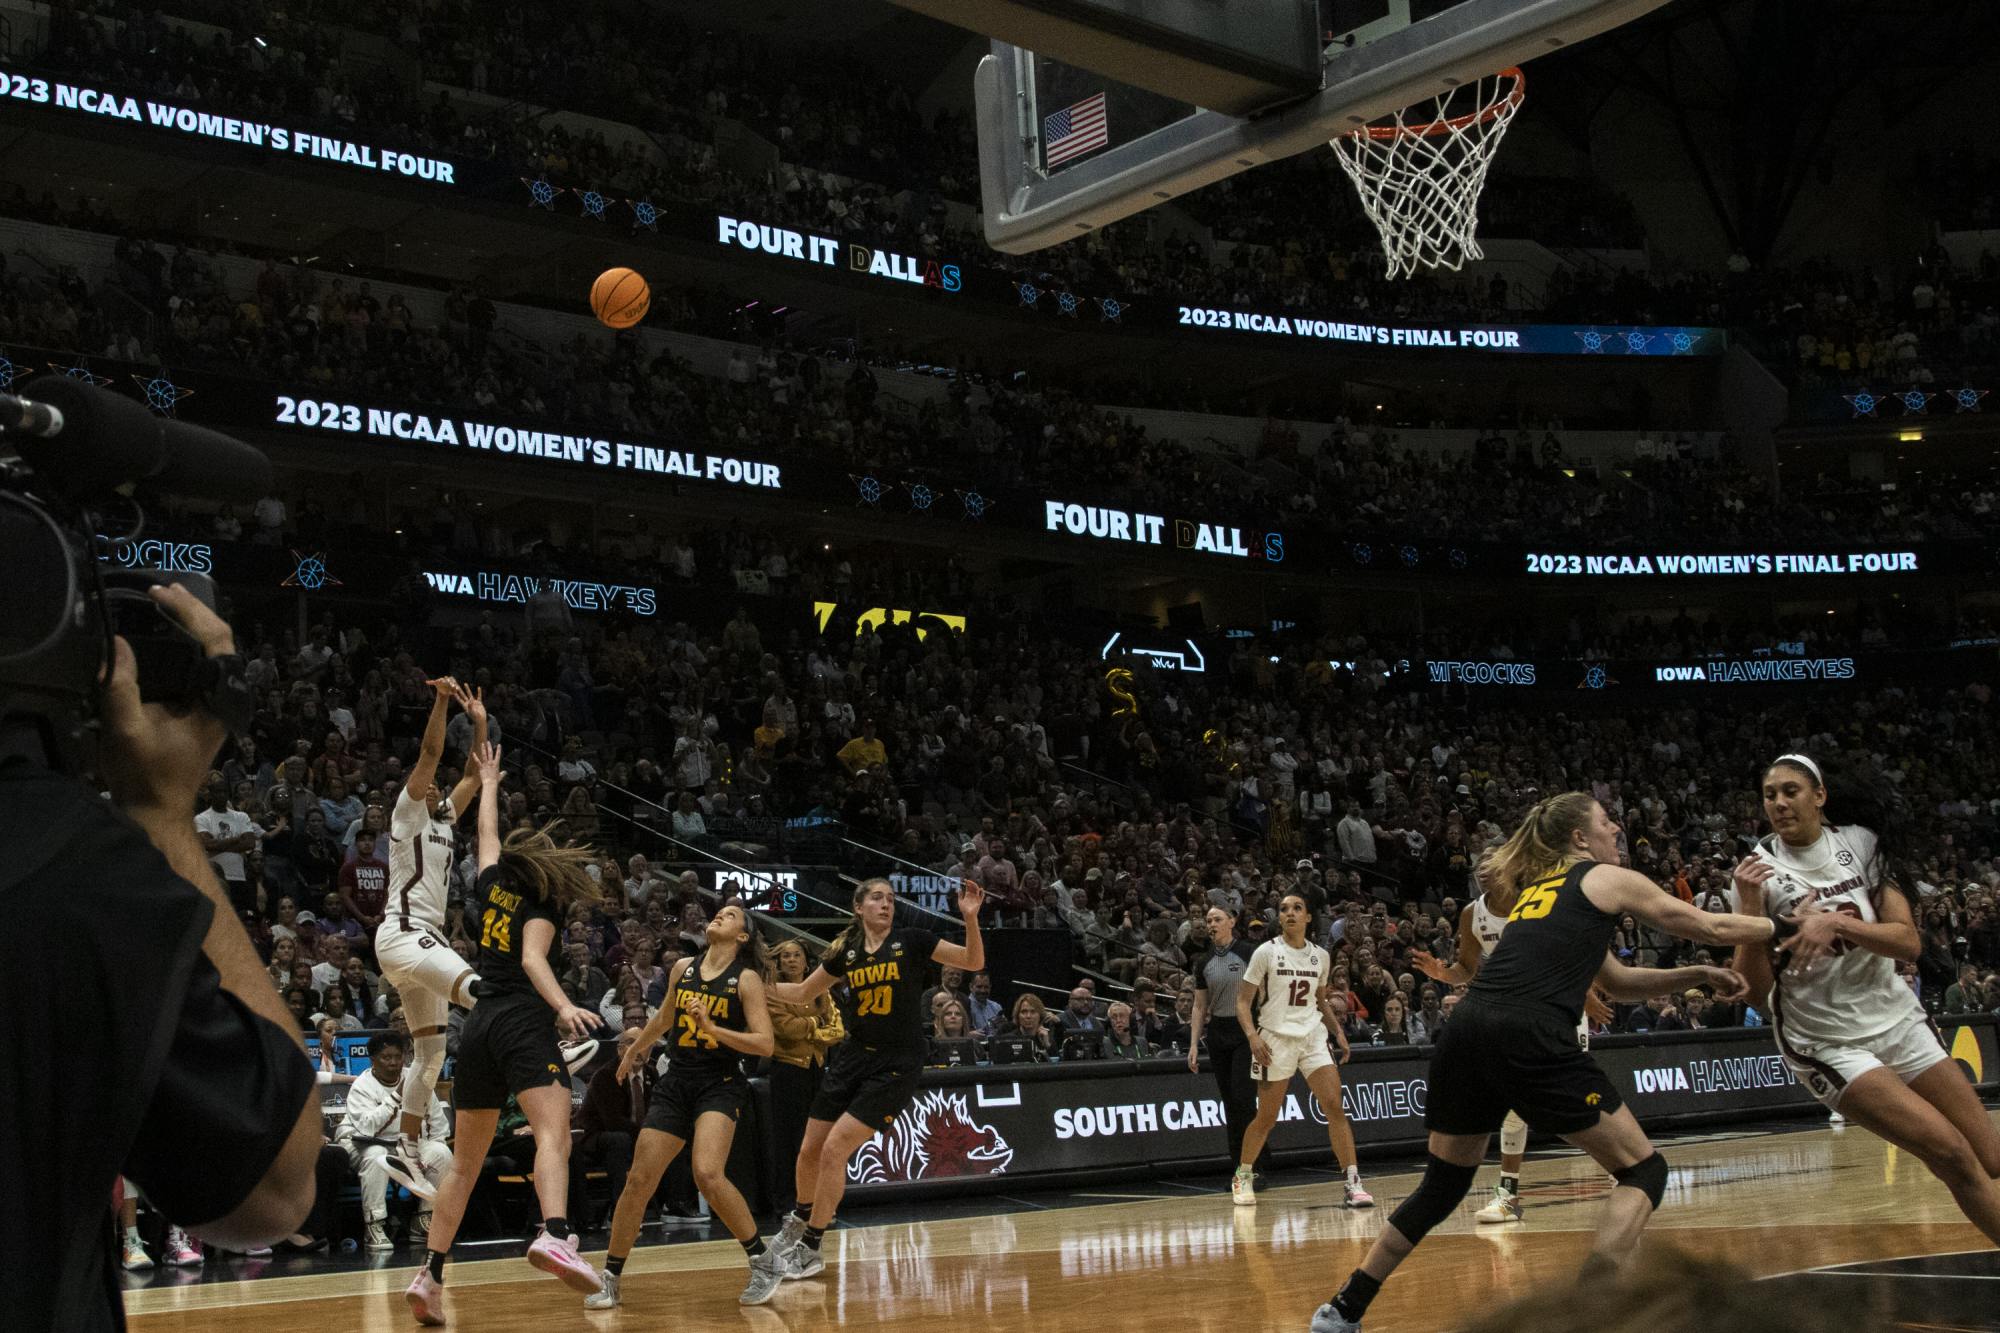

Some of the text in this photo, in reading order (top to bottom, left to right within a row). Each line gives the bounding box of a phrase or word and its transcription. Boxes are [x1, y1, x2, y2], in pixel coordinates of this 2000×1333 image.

[55, 83, 143, 122] NCAA
[146, 101, 290, 150] WOMEN’S
[294, 131, 377, 168] FINAL
[381, 149, 455, 184] FOUR
[718, 215, 962, 292] FOUR IT DALLAS
[1179, 306, 1520, 348] 2023 NCAA WOMEN’S FINAL FOUR
[276, 396, 782, 489] 2023 NCAA WOMEN’S FINAL FOUR
[1045, 500, 1286, 562] FOUR IT DALLAS
[1525, 552, 1919, 574] 2023 NCAA WOMEN’S FINAL FOUR
[1655, 657, 1857, 683] IOWA HAWKEYES
[358, 878, 385, 891] FOUR
[715, 871, 775, 891] FOUR
[1823, 875, 1864, 898] CAROLINA
[1506, 877, 1567, 922] 25
[480, 907, 511, 953] 14
[847, 961, 900, 989] IOWA
[675, 988, 729, 1019] IOWA
[856, 985, 893, 1017] 20
[1288, 979, 1310, 1006] 12
[1633, 1054, 1796, 1094] IOWA HAWKEY
[1053, 1103, 1159, 1139] SOUTH
